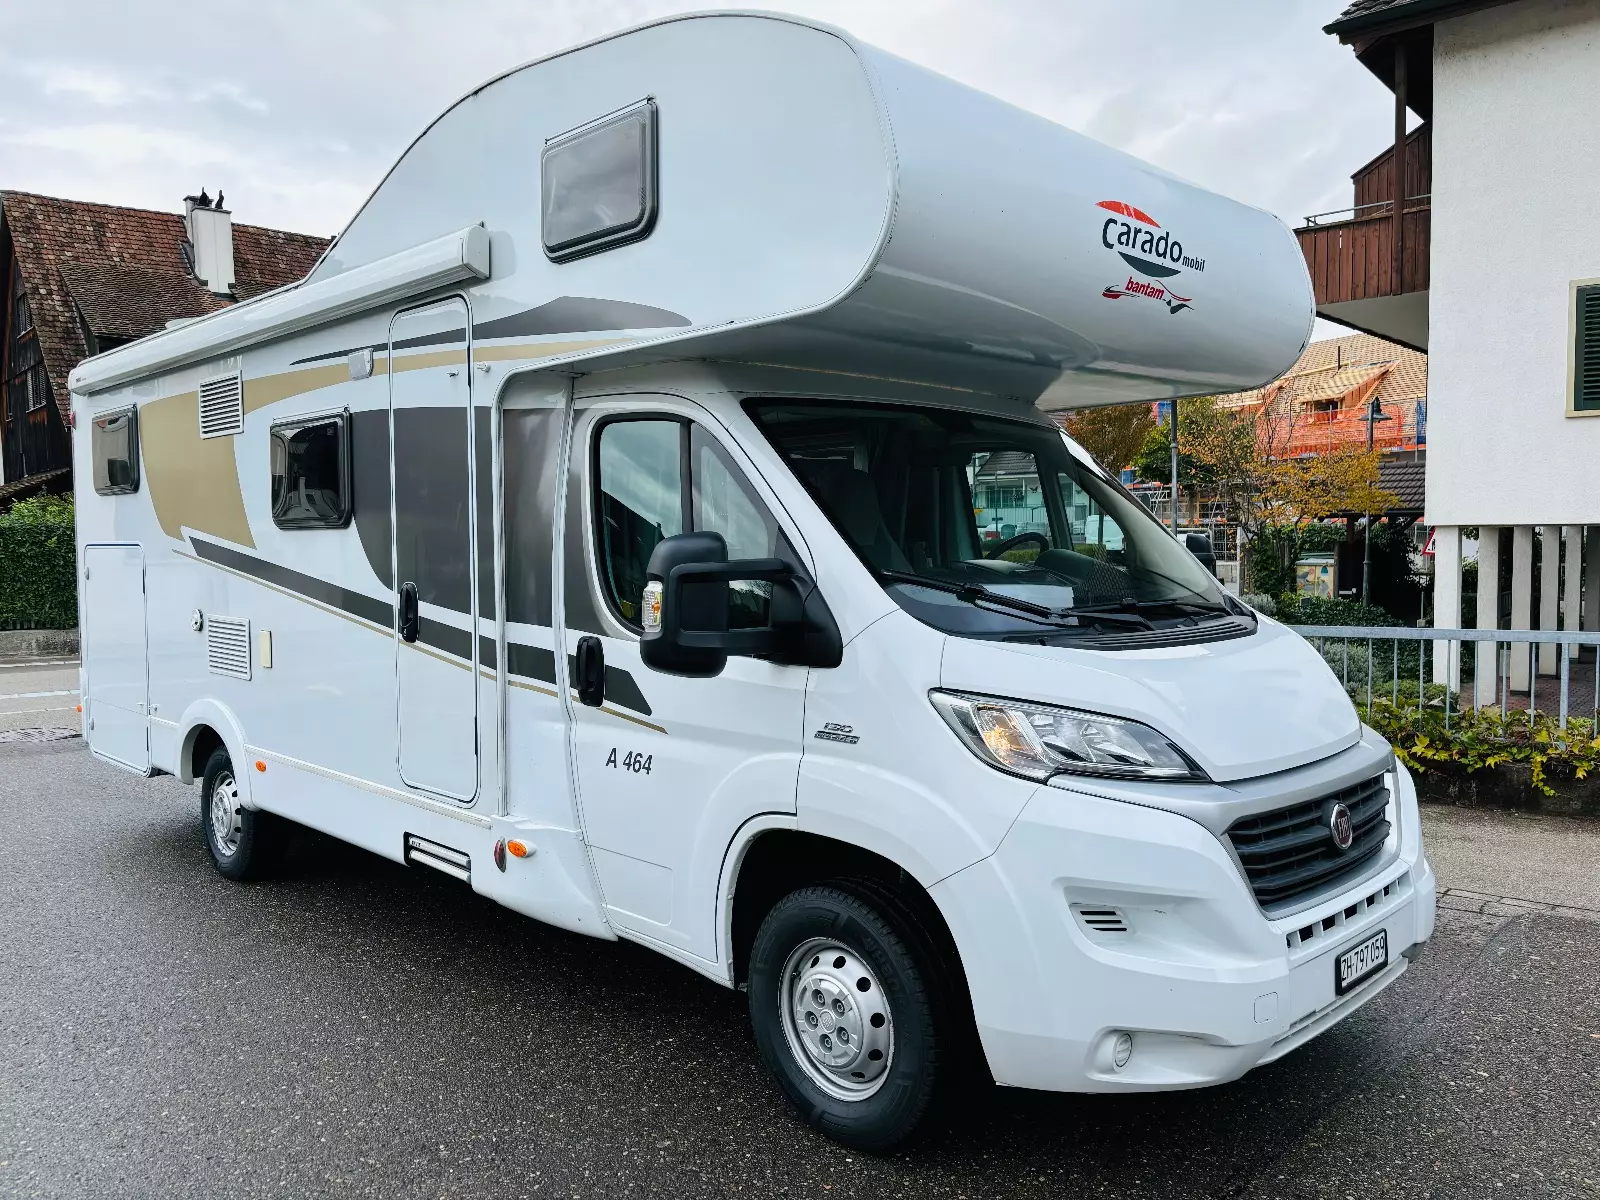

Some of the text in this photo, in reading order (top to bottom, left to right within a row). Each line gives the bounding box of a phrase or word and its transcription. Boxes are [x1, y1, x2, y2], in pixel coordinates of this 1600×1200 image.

[1102, 218, 1205, 272] Carado mobil
[1125, 276, 1165, 300] bantam
[605, 747, 653, 775] A 464
[1371, 935, 1385, 963] 059
